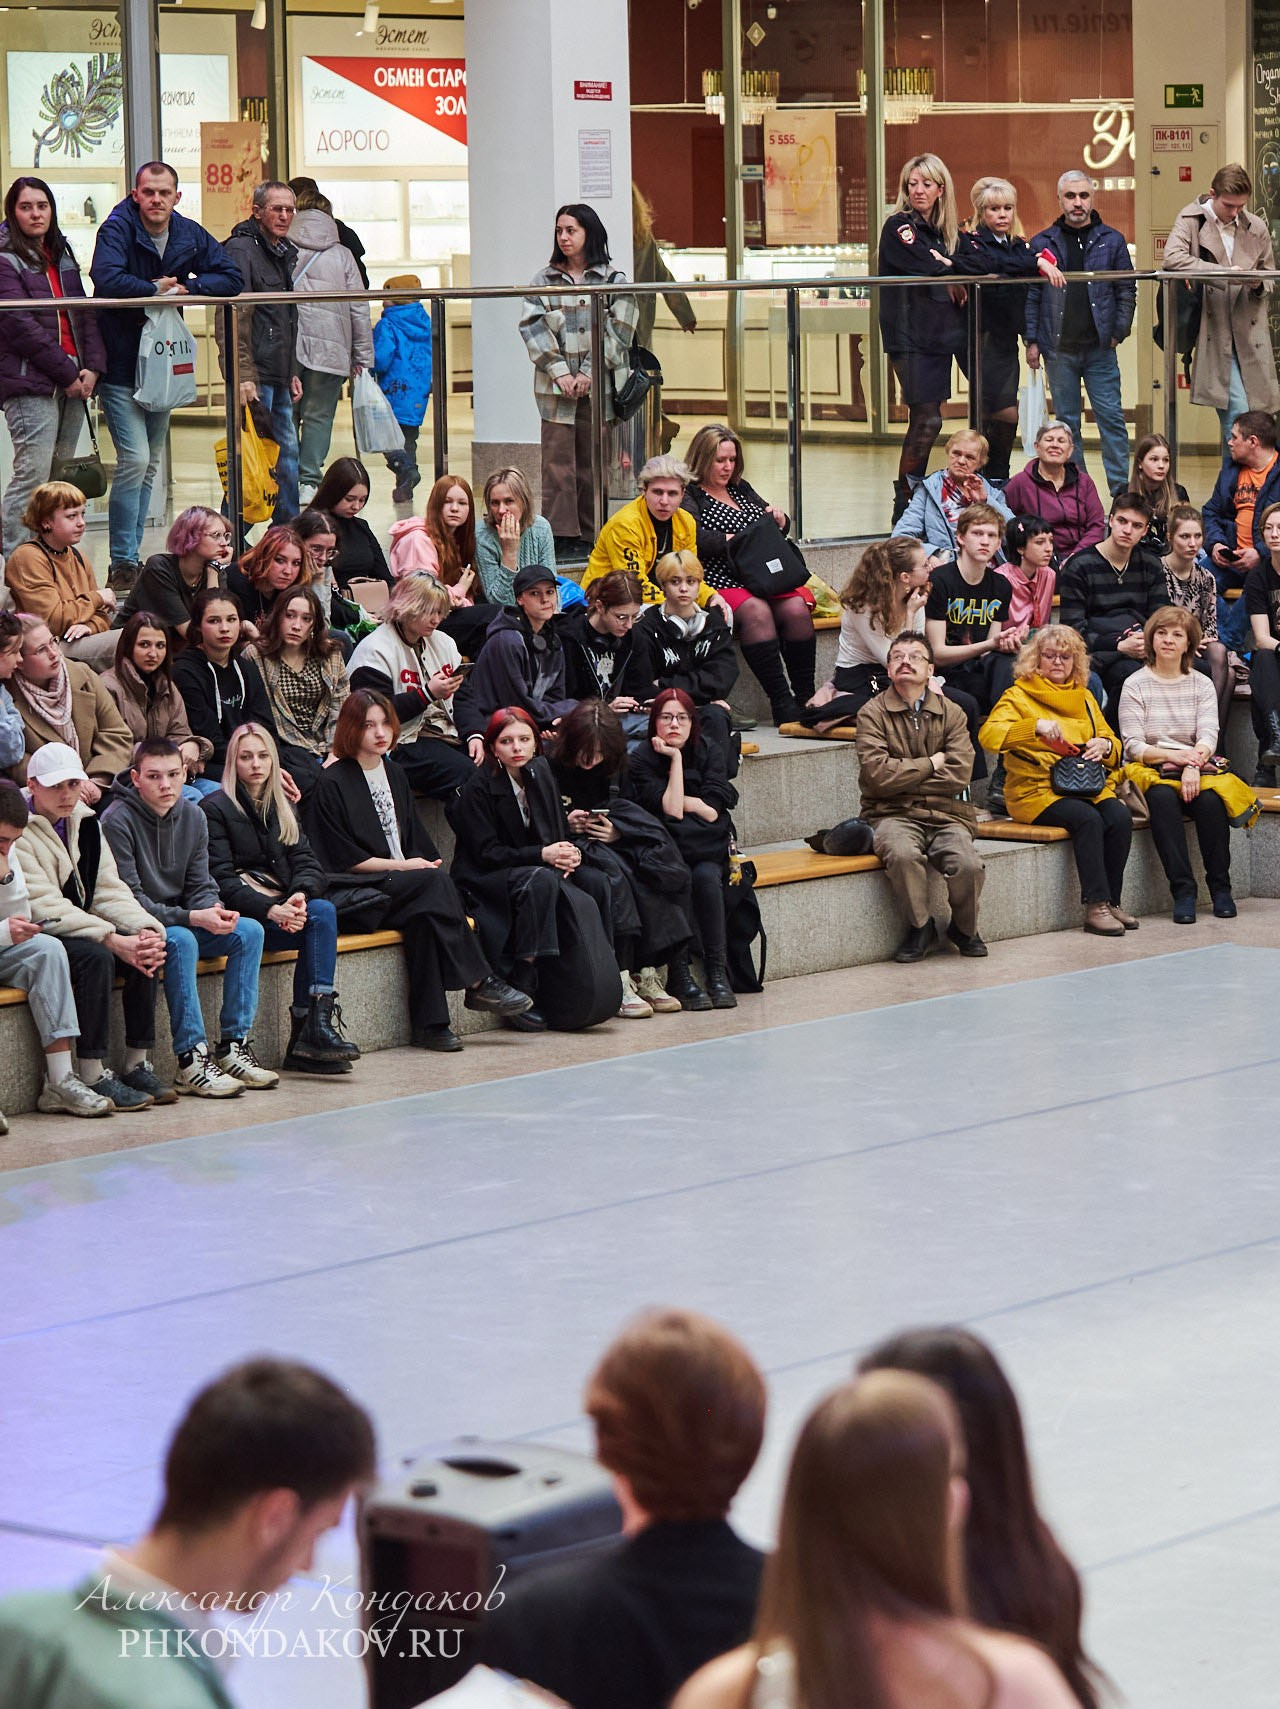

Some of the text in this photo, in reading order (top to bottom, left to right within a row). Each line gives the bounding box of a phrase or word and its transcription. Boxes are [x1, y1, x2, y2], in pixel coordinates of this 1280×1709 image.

[373, 67, 425, 87] ОБМЕН
[316, 129, 390, 154] ДОРОГО
[206, 163, 234, 186] 88
